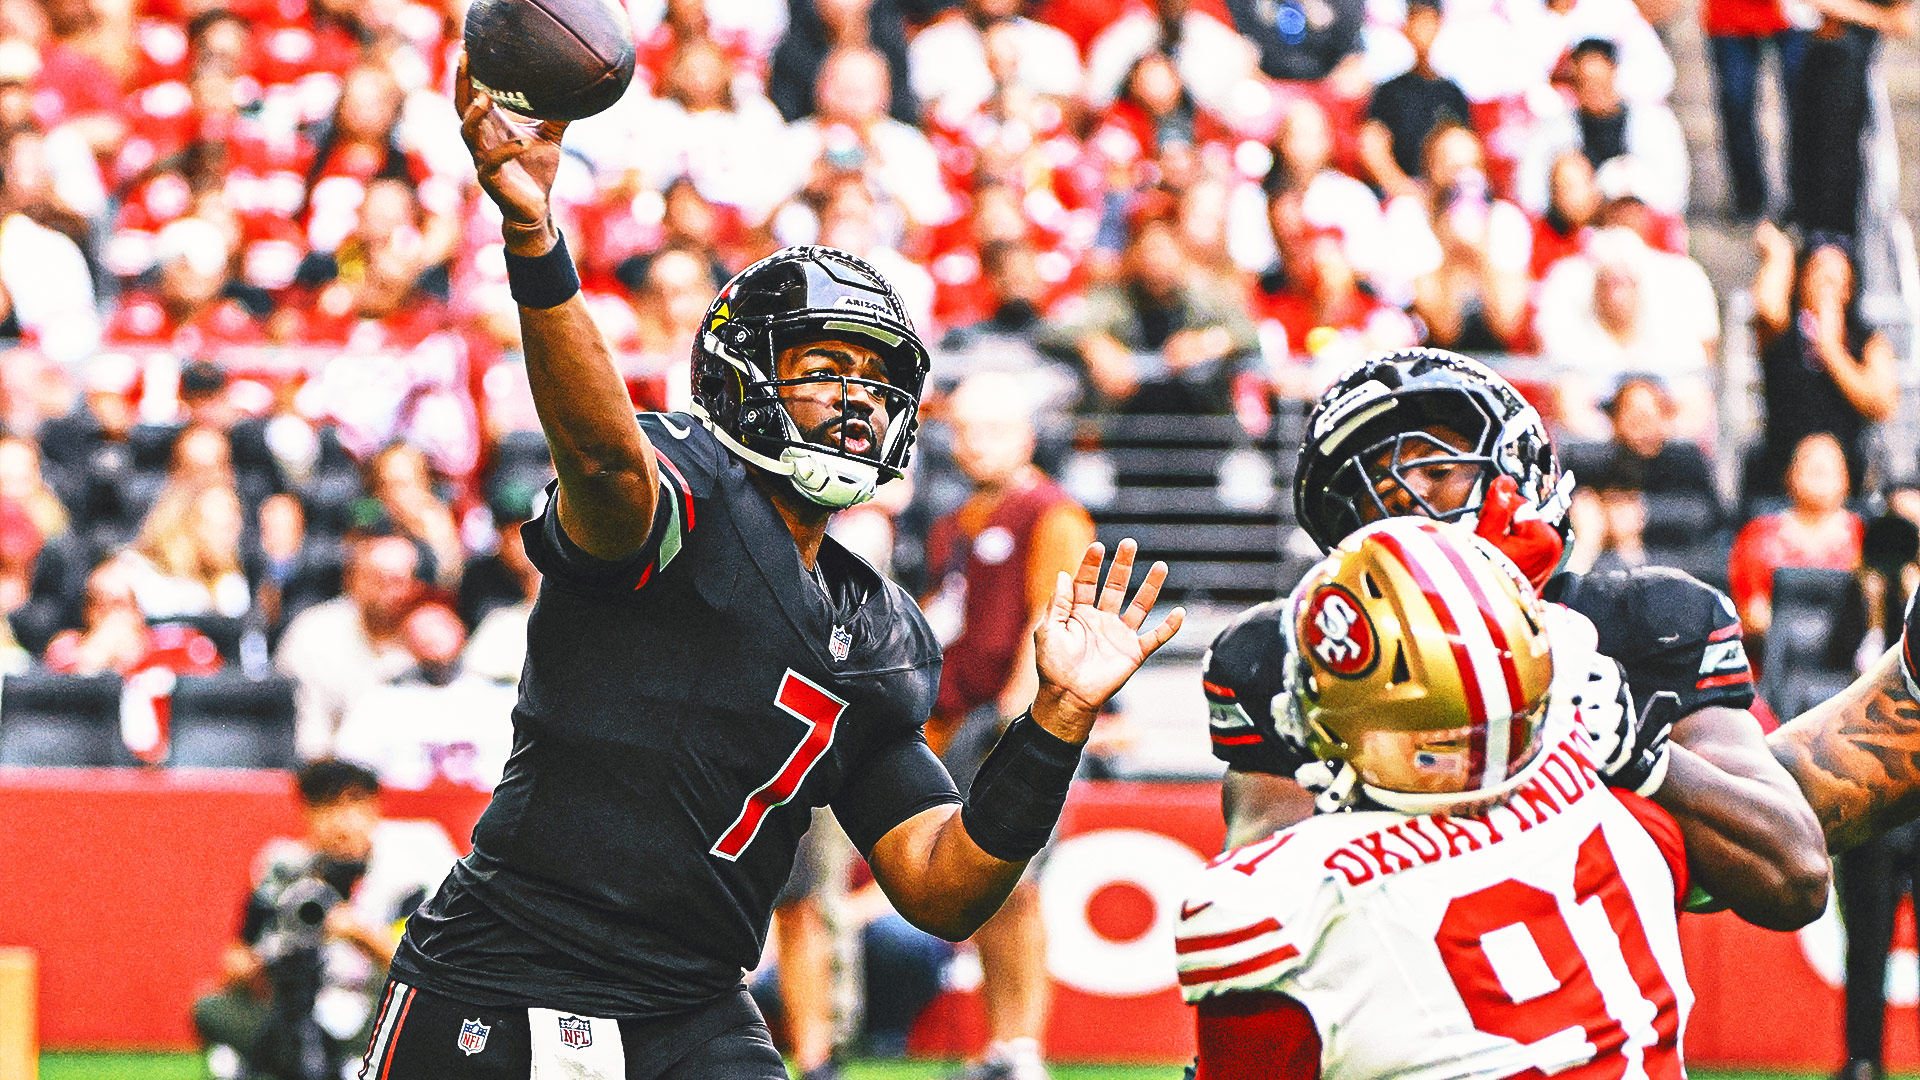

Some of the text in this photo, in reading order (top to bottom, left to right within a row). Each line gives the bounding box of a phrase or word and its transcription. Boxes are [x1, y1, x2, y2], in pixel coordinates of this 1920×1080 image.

[845, 298, 893, 316] ARIZONA
[709, 667, 850, 862] 7
[1324, 706, 1600, 887] OKUAYINON
[1434, 822, 1680, 1080] 91
[462, 1032, 481, 1049] NFL
[563, 1028, 590, 1046] NFL
